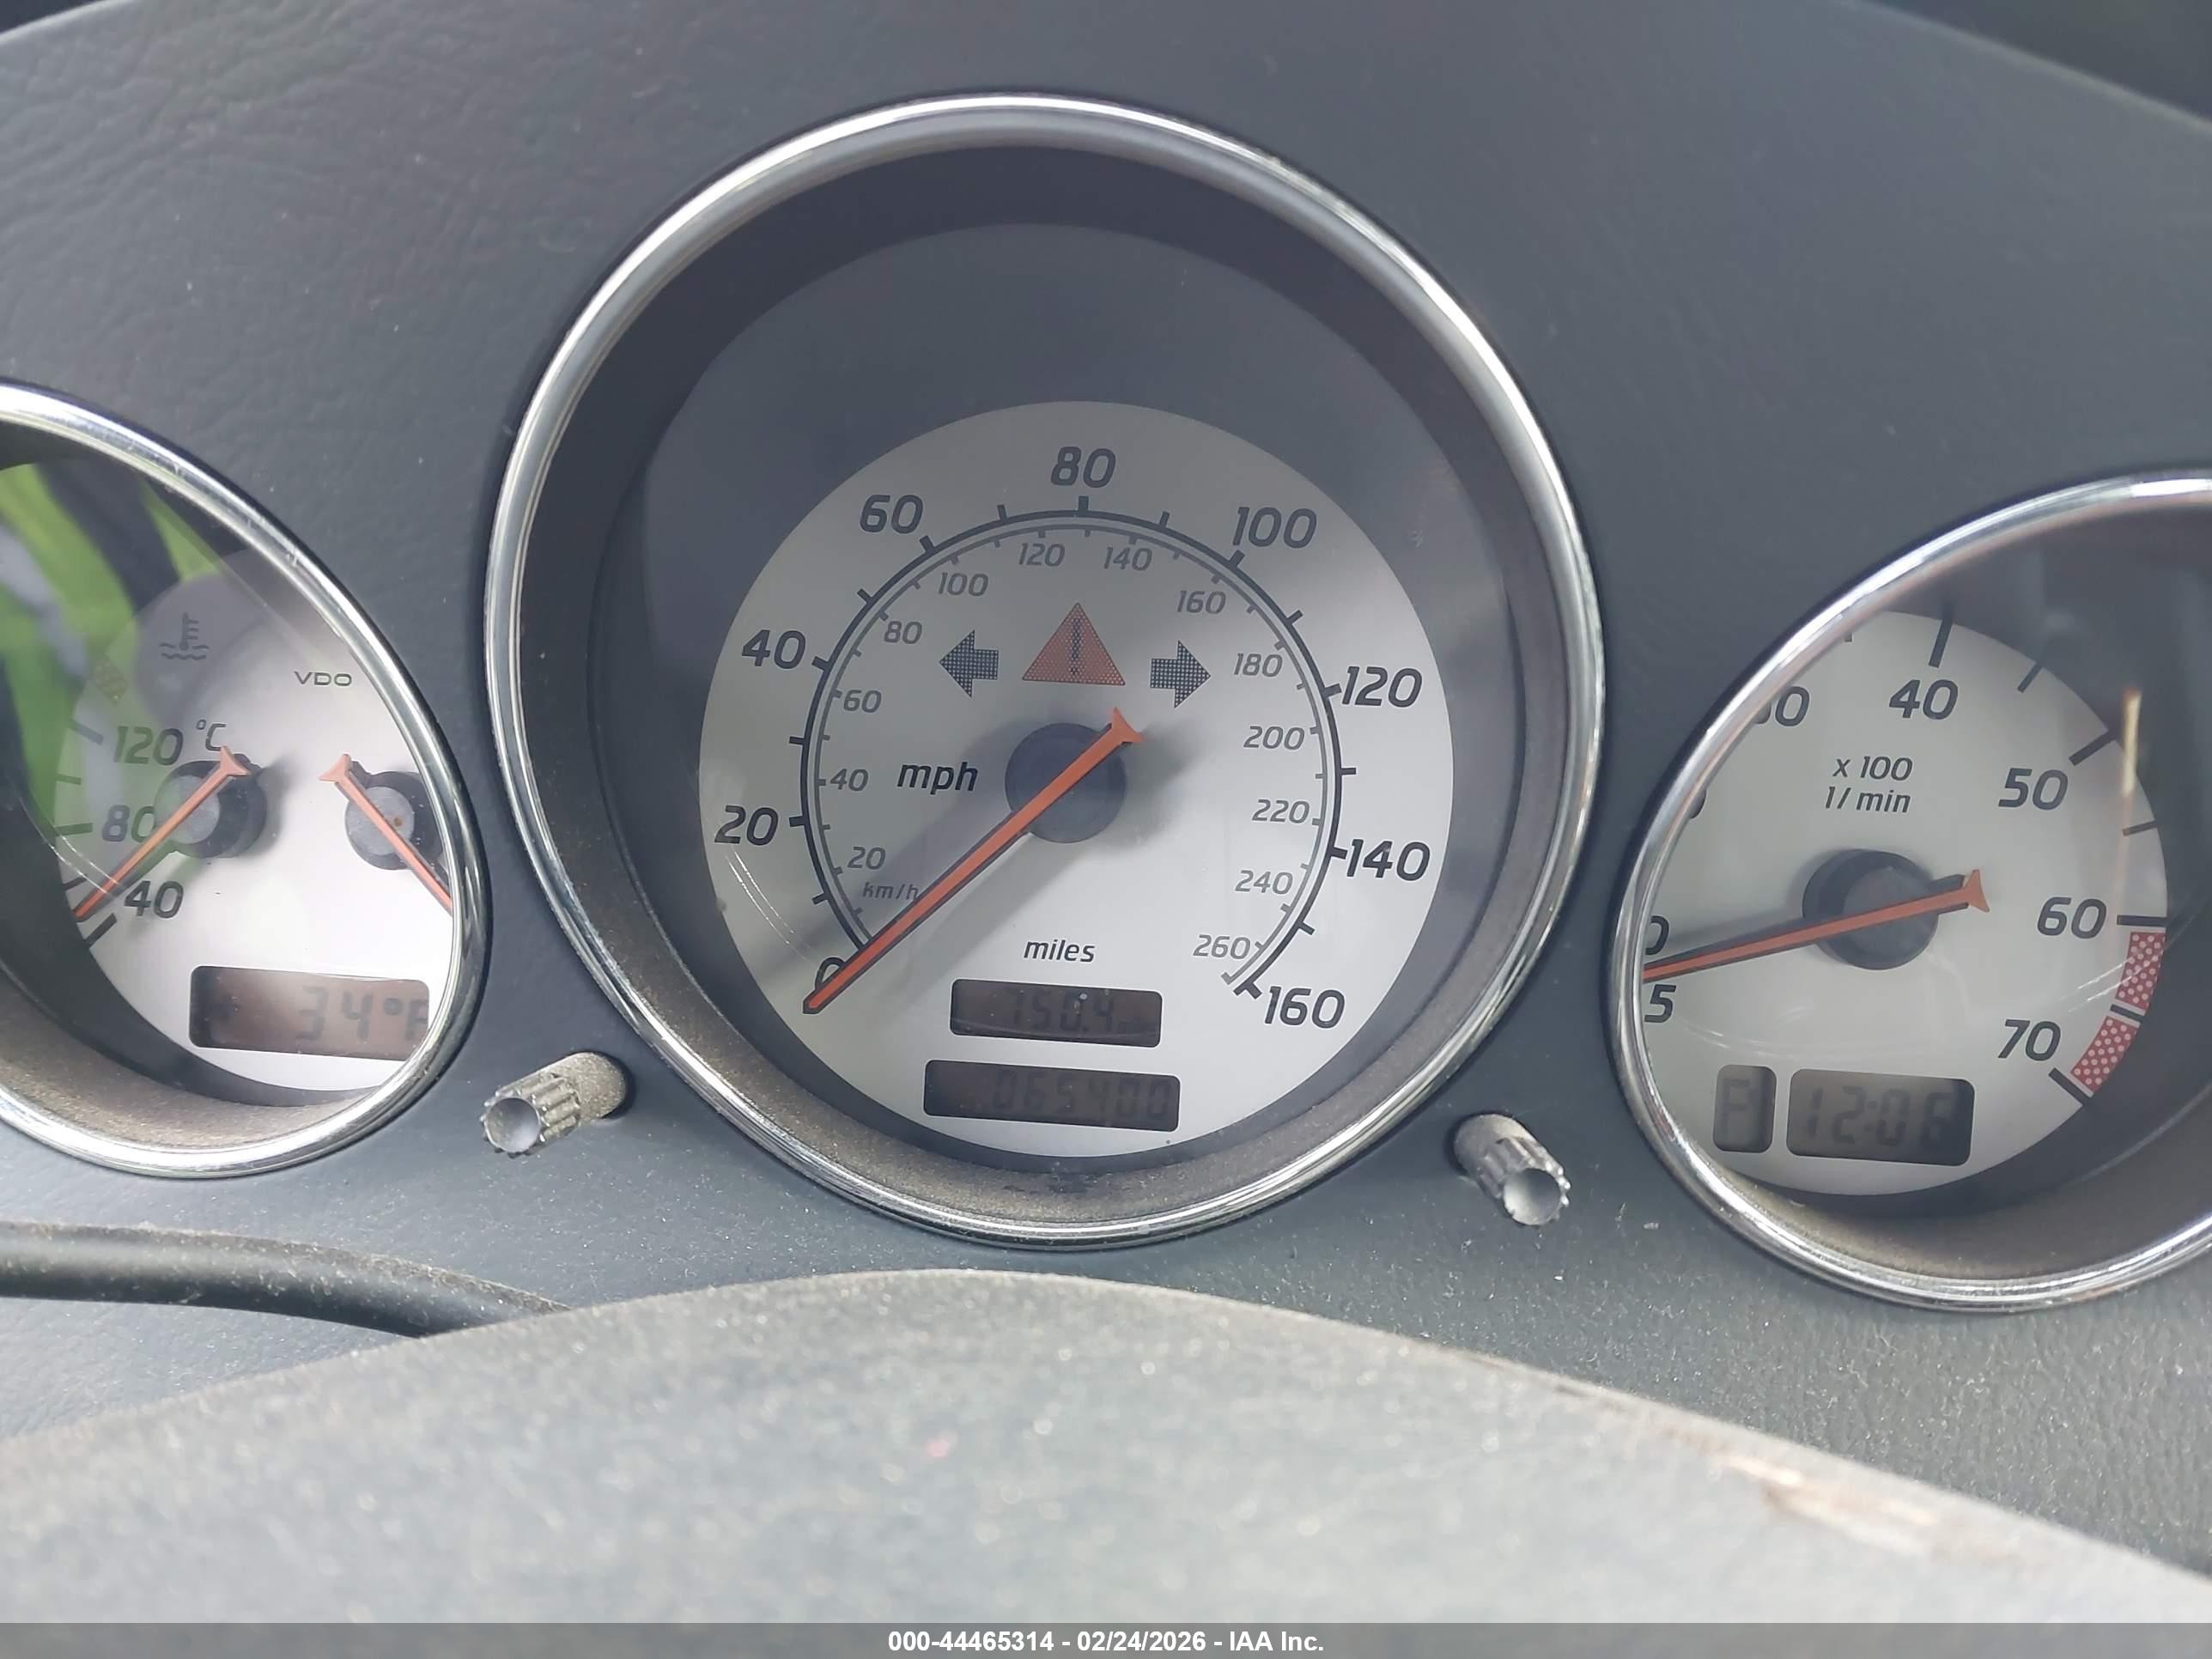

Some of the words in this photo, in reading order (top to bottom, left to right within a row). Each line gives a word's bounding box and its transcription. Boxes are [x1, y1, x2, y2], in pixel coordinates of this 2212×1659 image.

[1050, 446, 1116, 489] 80
[860, 494, 924, 534] 60
[1231, 506, 1317, 549] 100
[1018, 543, 1066, 568] 120
[1103, 546, 1152, 571] 140
[939, 571, 989, 598] 100
[1176, 590, 1226, 615] 160
[883, 620, 923, 645] 80
[741, 629, 806, 670] 40
[294, 671, 353, 687] VDO
[1233, 653, 1283, 678] 180
[1341, 665, 1423, 708] 120
[1888, 678, 1959, 720] 40
[842, 689, 882, 714] 60
[113, 726, 185, 766] 120
[1243, 726, 1305, 750] 200
[830, 768, 869, 792] 40
[896, 762, 978, 795] mph
[1832, 758, 1851, 778] x
[1859, 756, 1913, 781] 100
[1856, 788, 1911, 814] min
[1997, 767, 2069, 811] 50
[101, 804, 156, 844] 80
[1251, 799, 1310, 824] 220
[714, 805, 779, 847] 20
[847, 846, 886, 870] 20
[1346, 838, 1431, 882] 140
[862, 881, 919, 901] km/h
[1234, 869, 1293, 895] 240
[123, 879, 185, 919] 40
[2036, 896, 2107, 939] 60
[1023, 939, 1095, 963] miles
[1192, 933, 1251, 960] 260
[1264, 986, 1346, 1029] 160
[1644, 983, 1677, 1024] 5
[1996, 1019, 2061, 1061] 70
